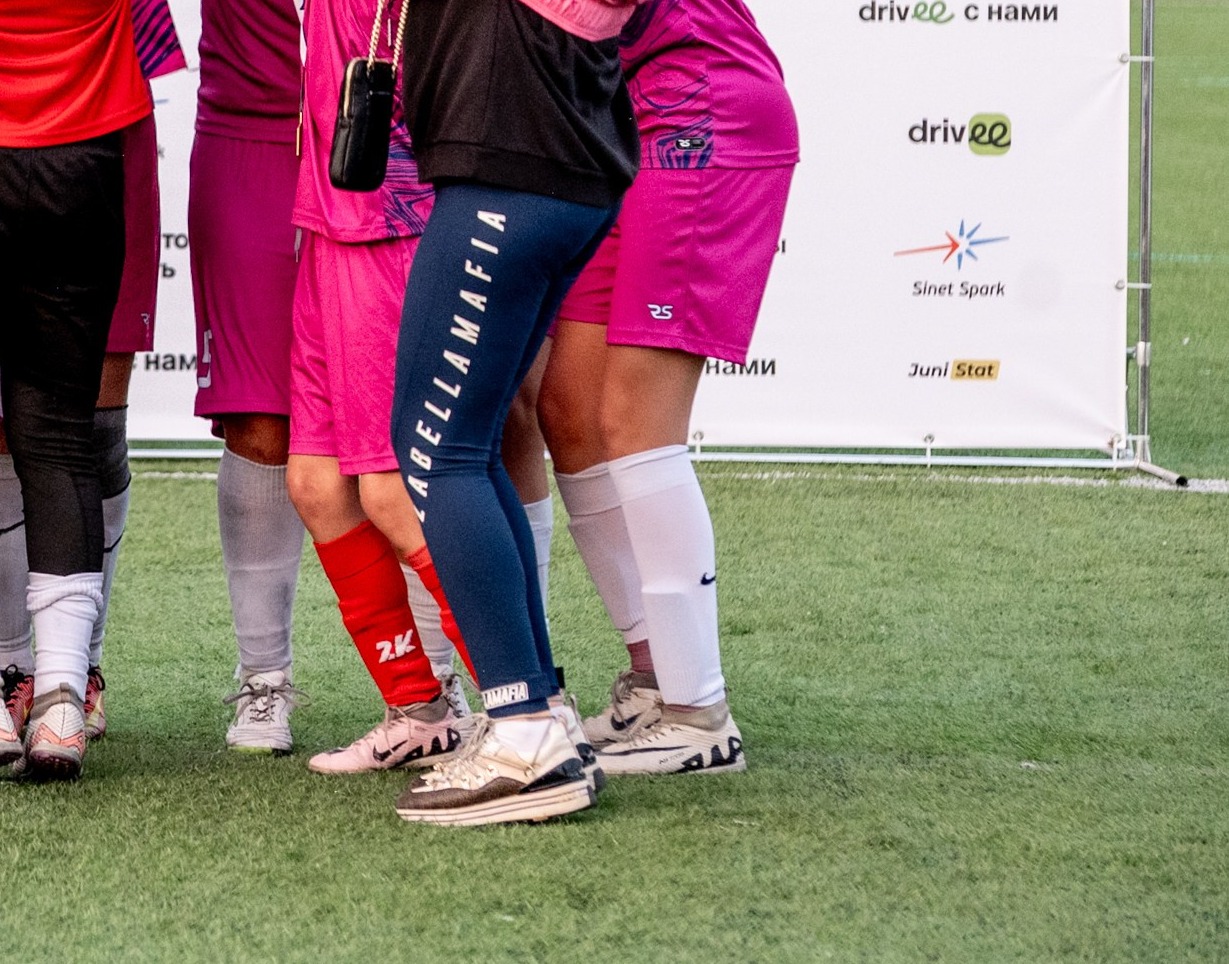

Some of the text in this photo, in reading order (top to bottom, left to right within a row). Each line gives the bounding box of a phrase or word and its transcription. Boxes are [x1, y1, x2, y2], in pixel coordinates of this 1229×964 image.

[858, 0, 1058, 24] drivee с нами
[908, 116, 1011, 151] drivee
[912, 280, 1005, 300] Sinet Spark
[908, 361, 996, 378] Juni Stat
